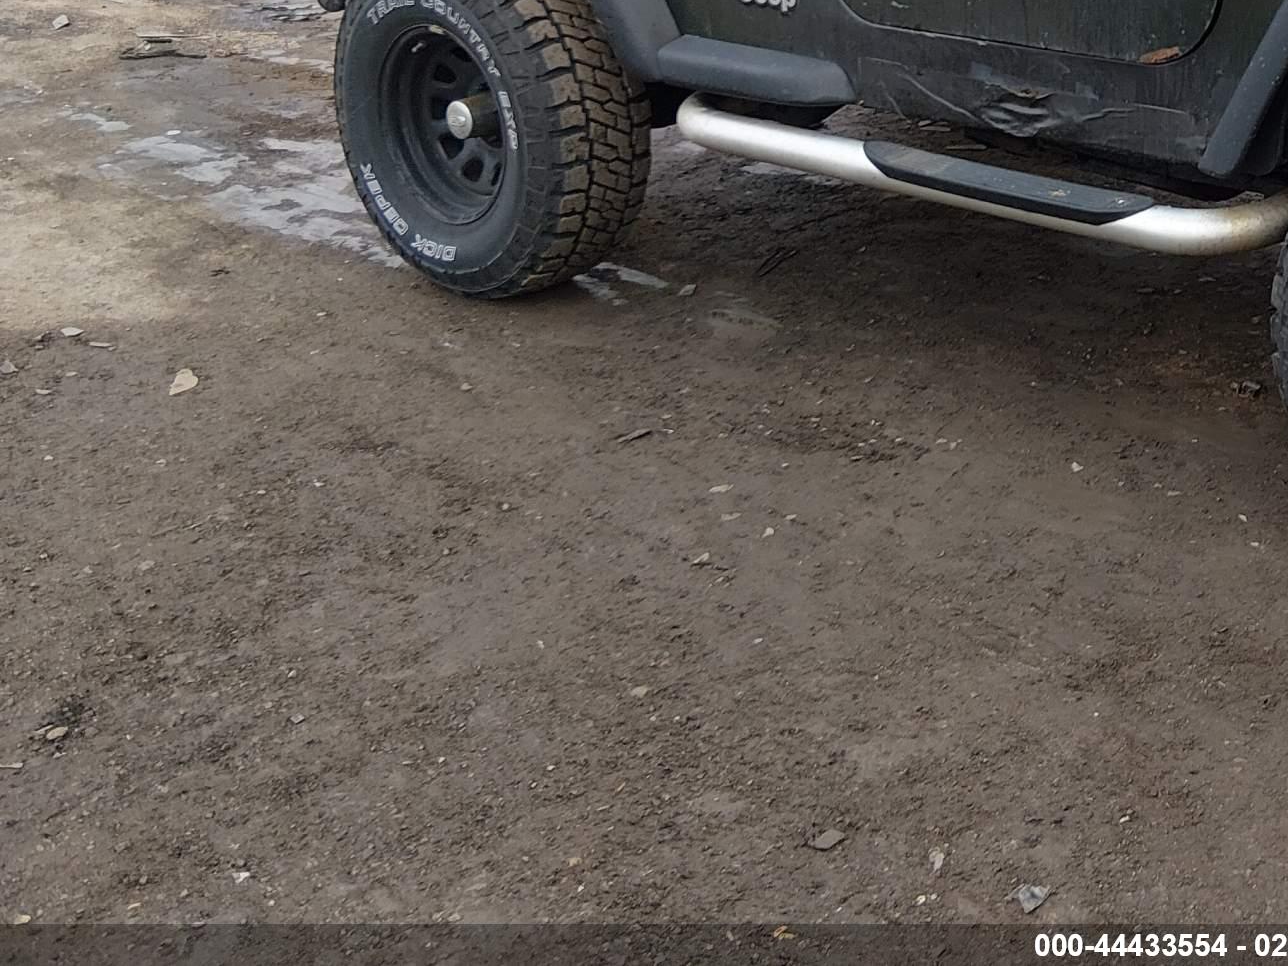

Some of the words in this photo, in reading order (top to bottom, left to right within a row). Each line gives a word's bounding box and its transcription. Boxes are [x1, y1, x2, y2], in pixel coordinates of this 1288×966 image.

[499, 91, 518, 150] EXP
[360, 162, 409, 236] CEPEK
[411, 234, 457, 262] DICK
